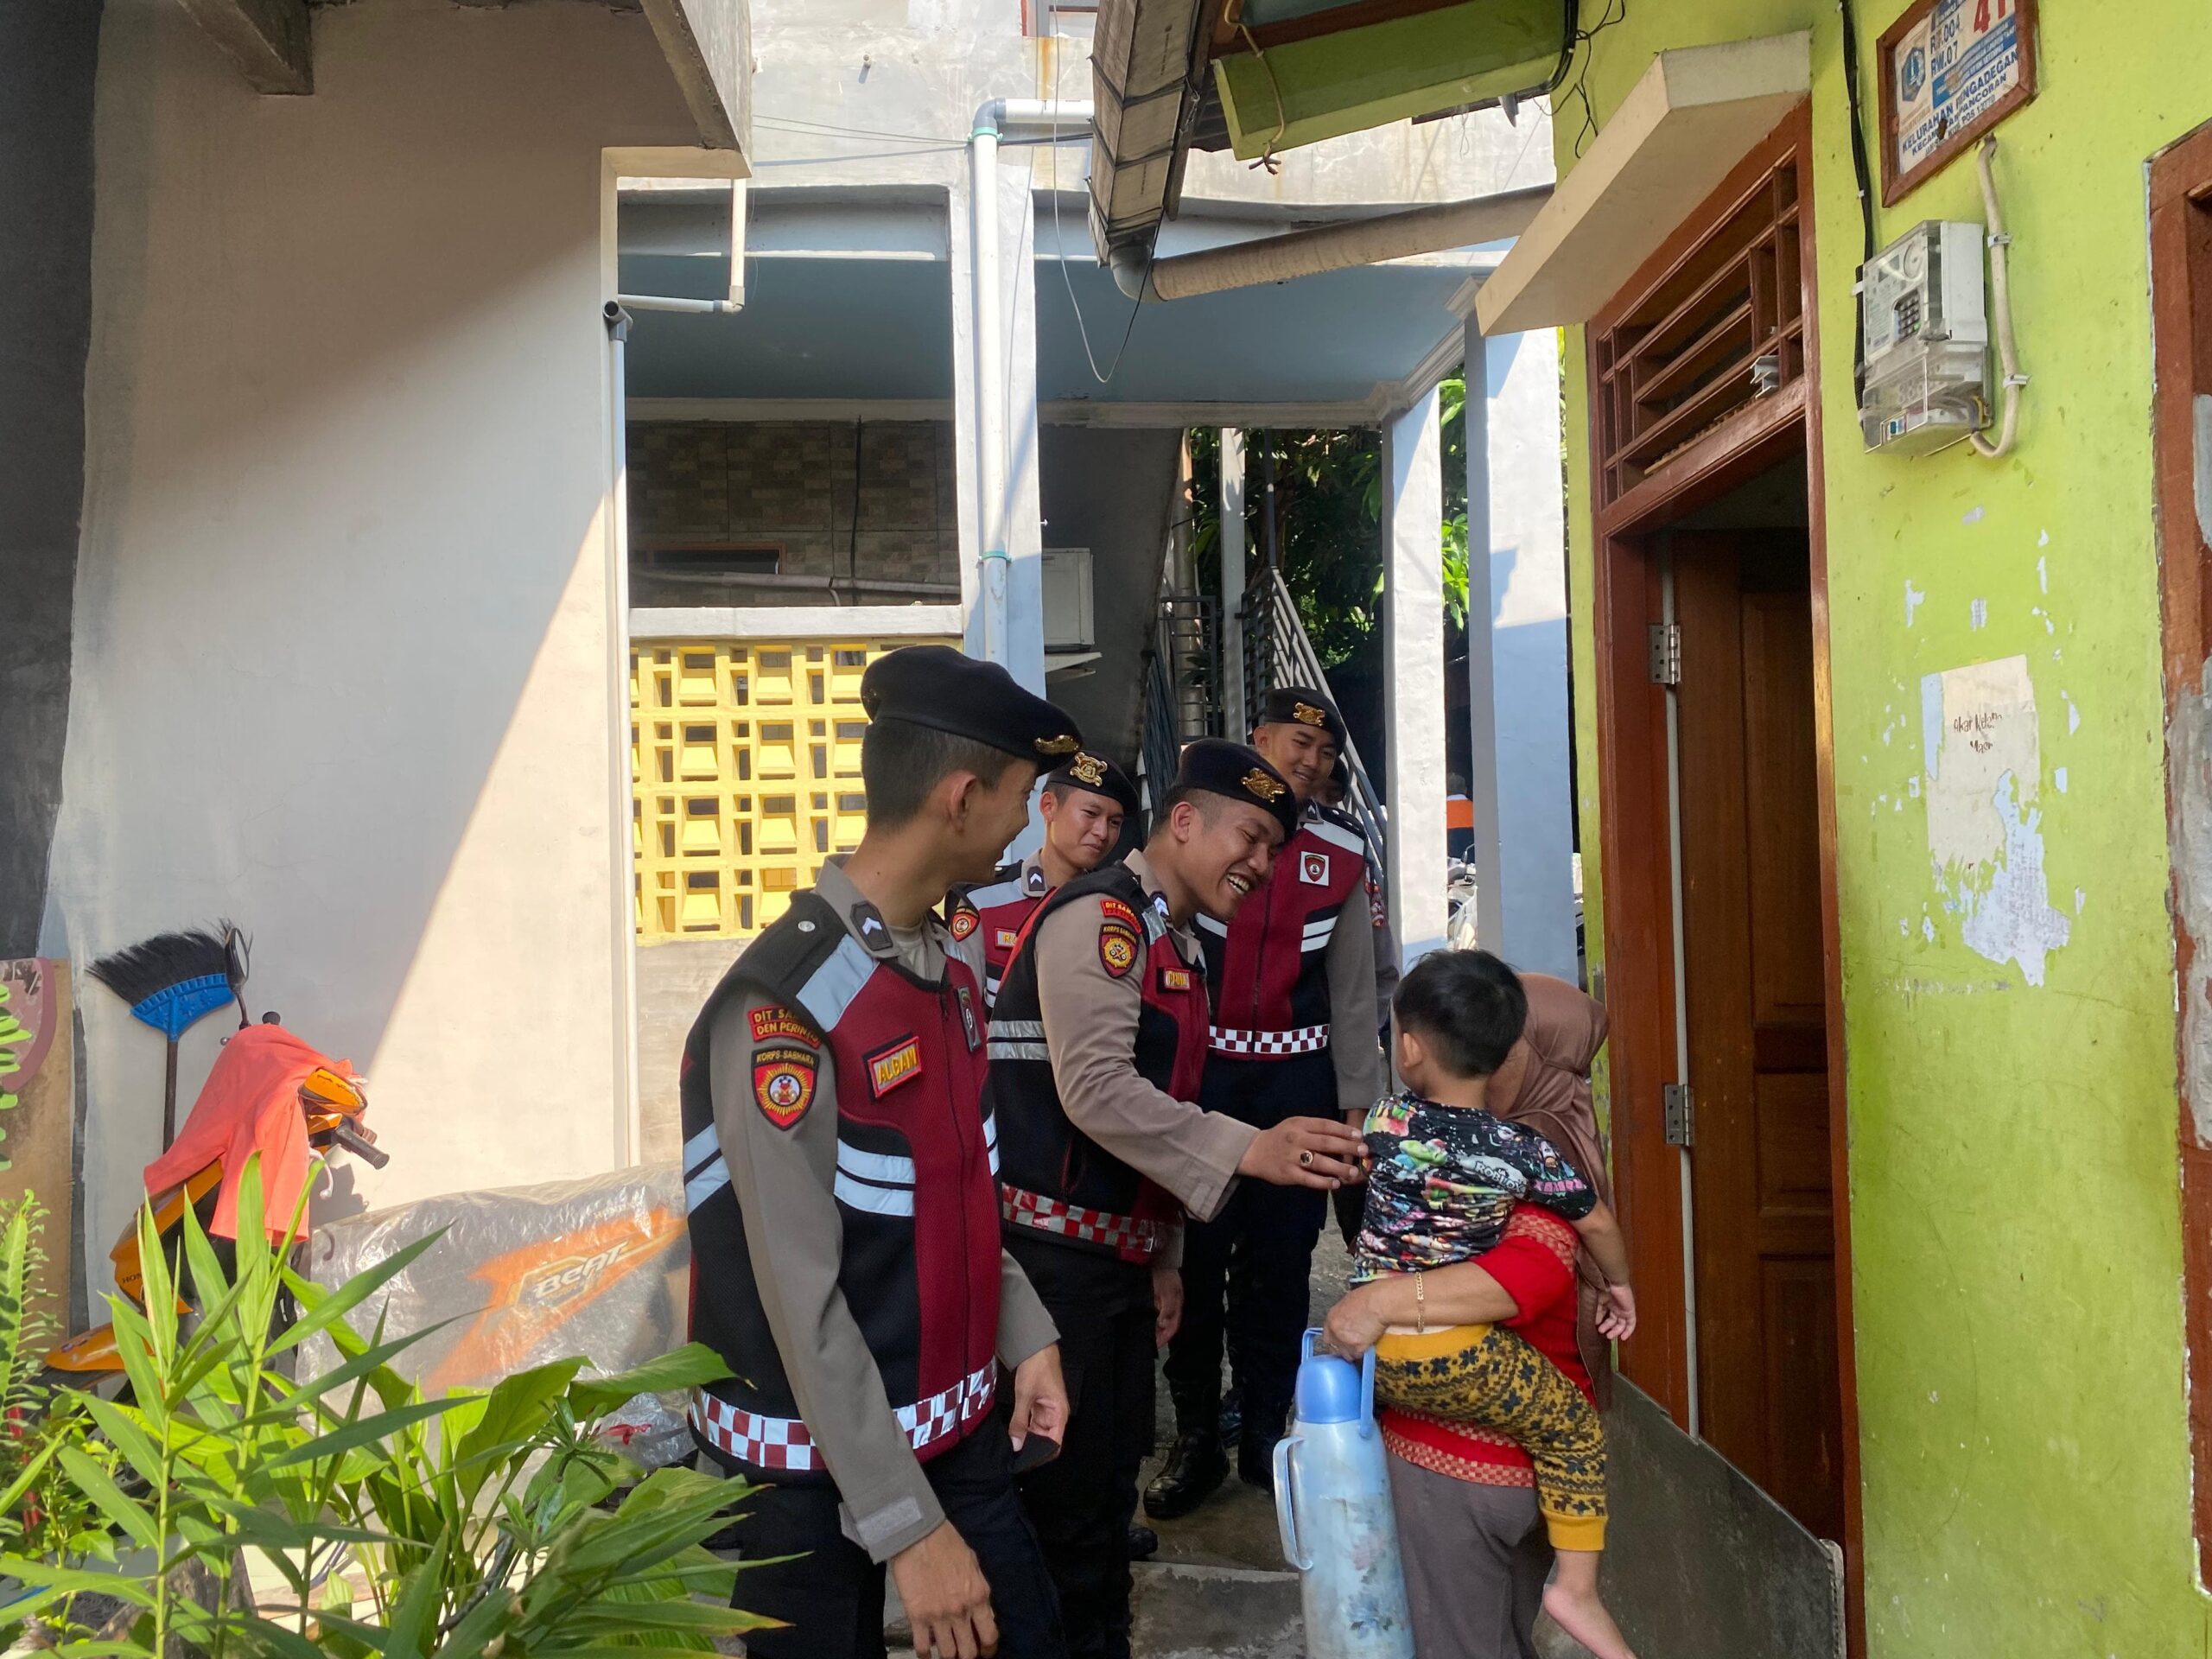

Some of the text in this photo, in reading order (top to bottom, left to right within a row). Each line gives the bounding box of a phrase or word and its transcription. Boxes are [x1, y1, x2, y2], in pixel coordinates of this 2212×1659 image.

[1903, 103, 1954, 153] KELURAHAN
[1955, 49, 2018, 109] PENGADEGAN
[1959, 73, 2006, 113] PANCORAN
[753, 1010, 772, 1023] DIT
[756, 1022, 777, 1036] DEN
[1474, 1160, 1522, 1192] ROBLOX
